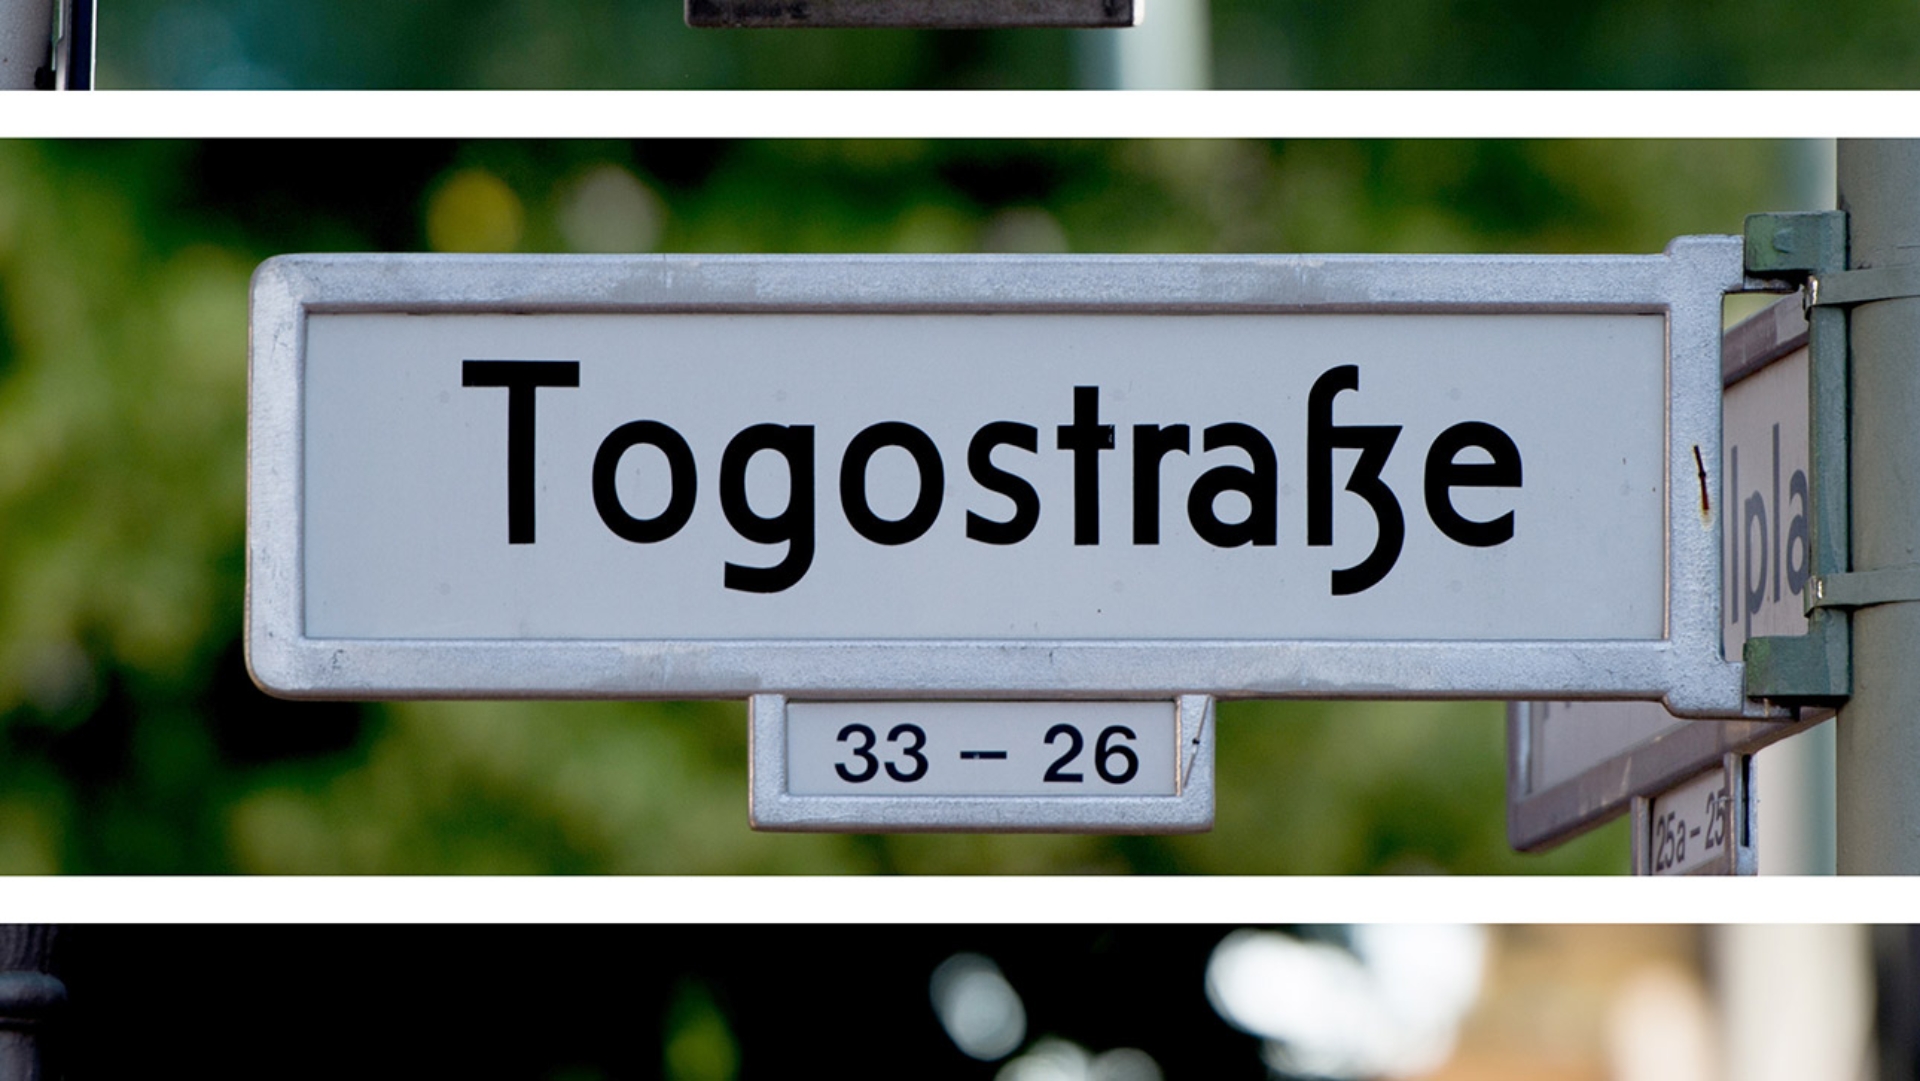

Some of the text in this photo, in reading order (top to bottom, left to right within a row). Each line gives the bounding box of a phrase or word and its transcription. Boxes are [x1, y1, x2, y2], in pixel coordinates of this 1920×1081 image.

[461, 359, 1525, 597] Togostraße
[834, 723, 929, 783] 33
[1043, 723, 1139, 785] 26
[1656, 811, 1686, 872] 25a
